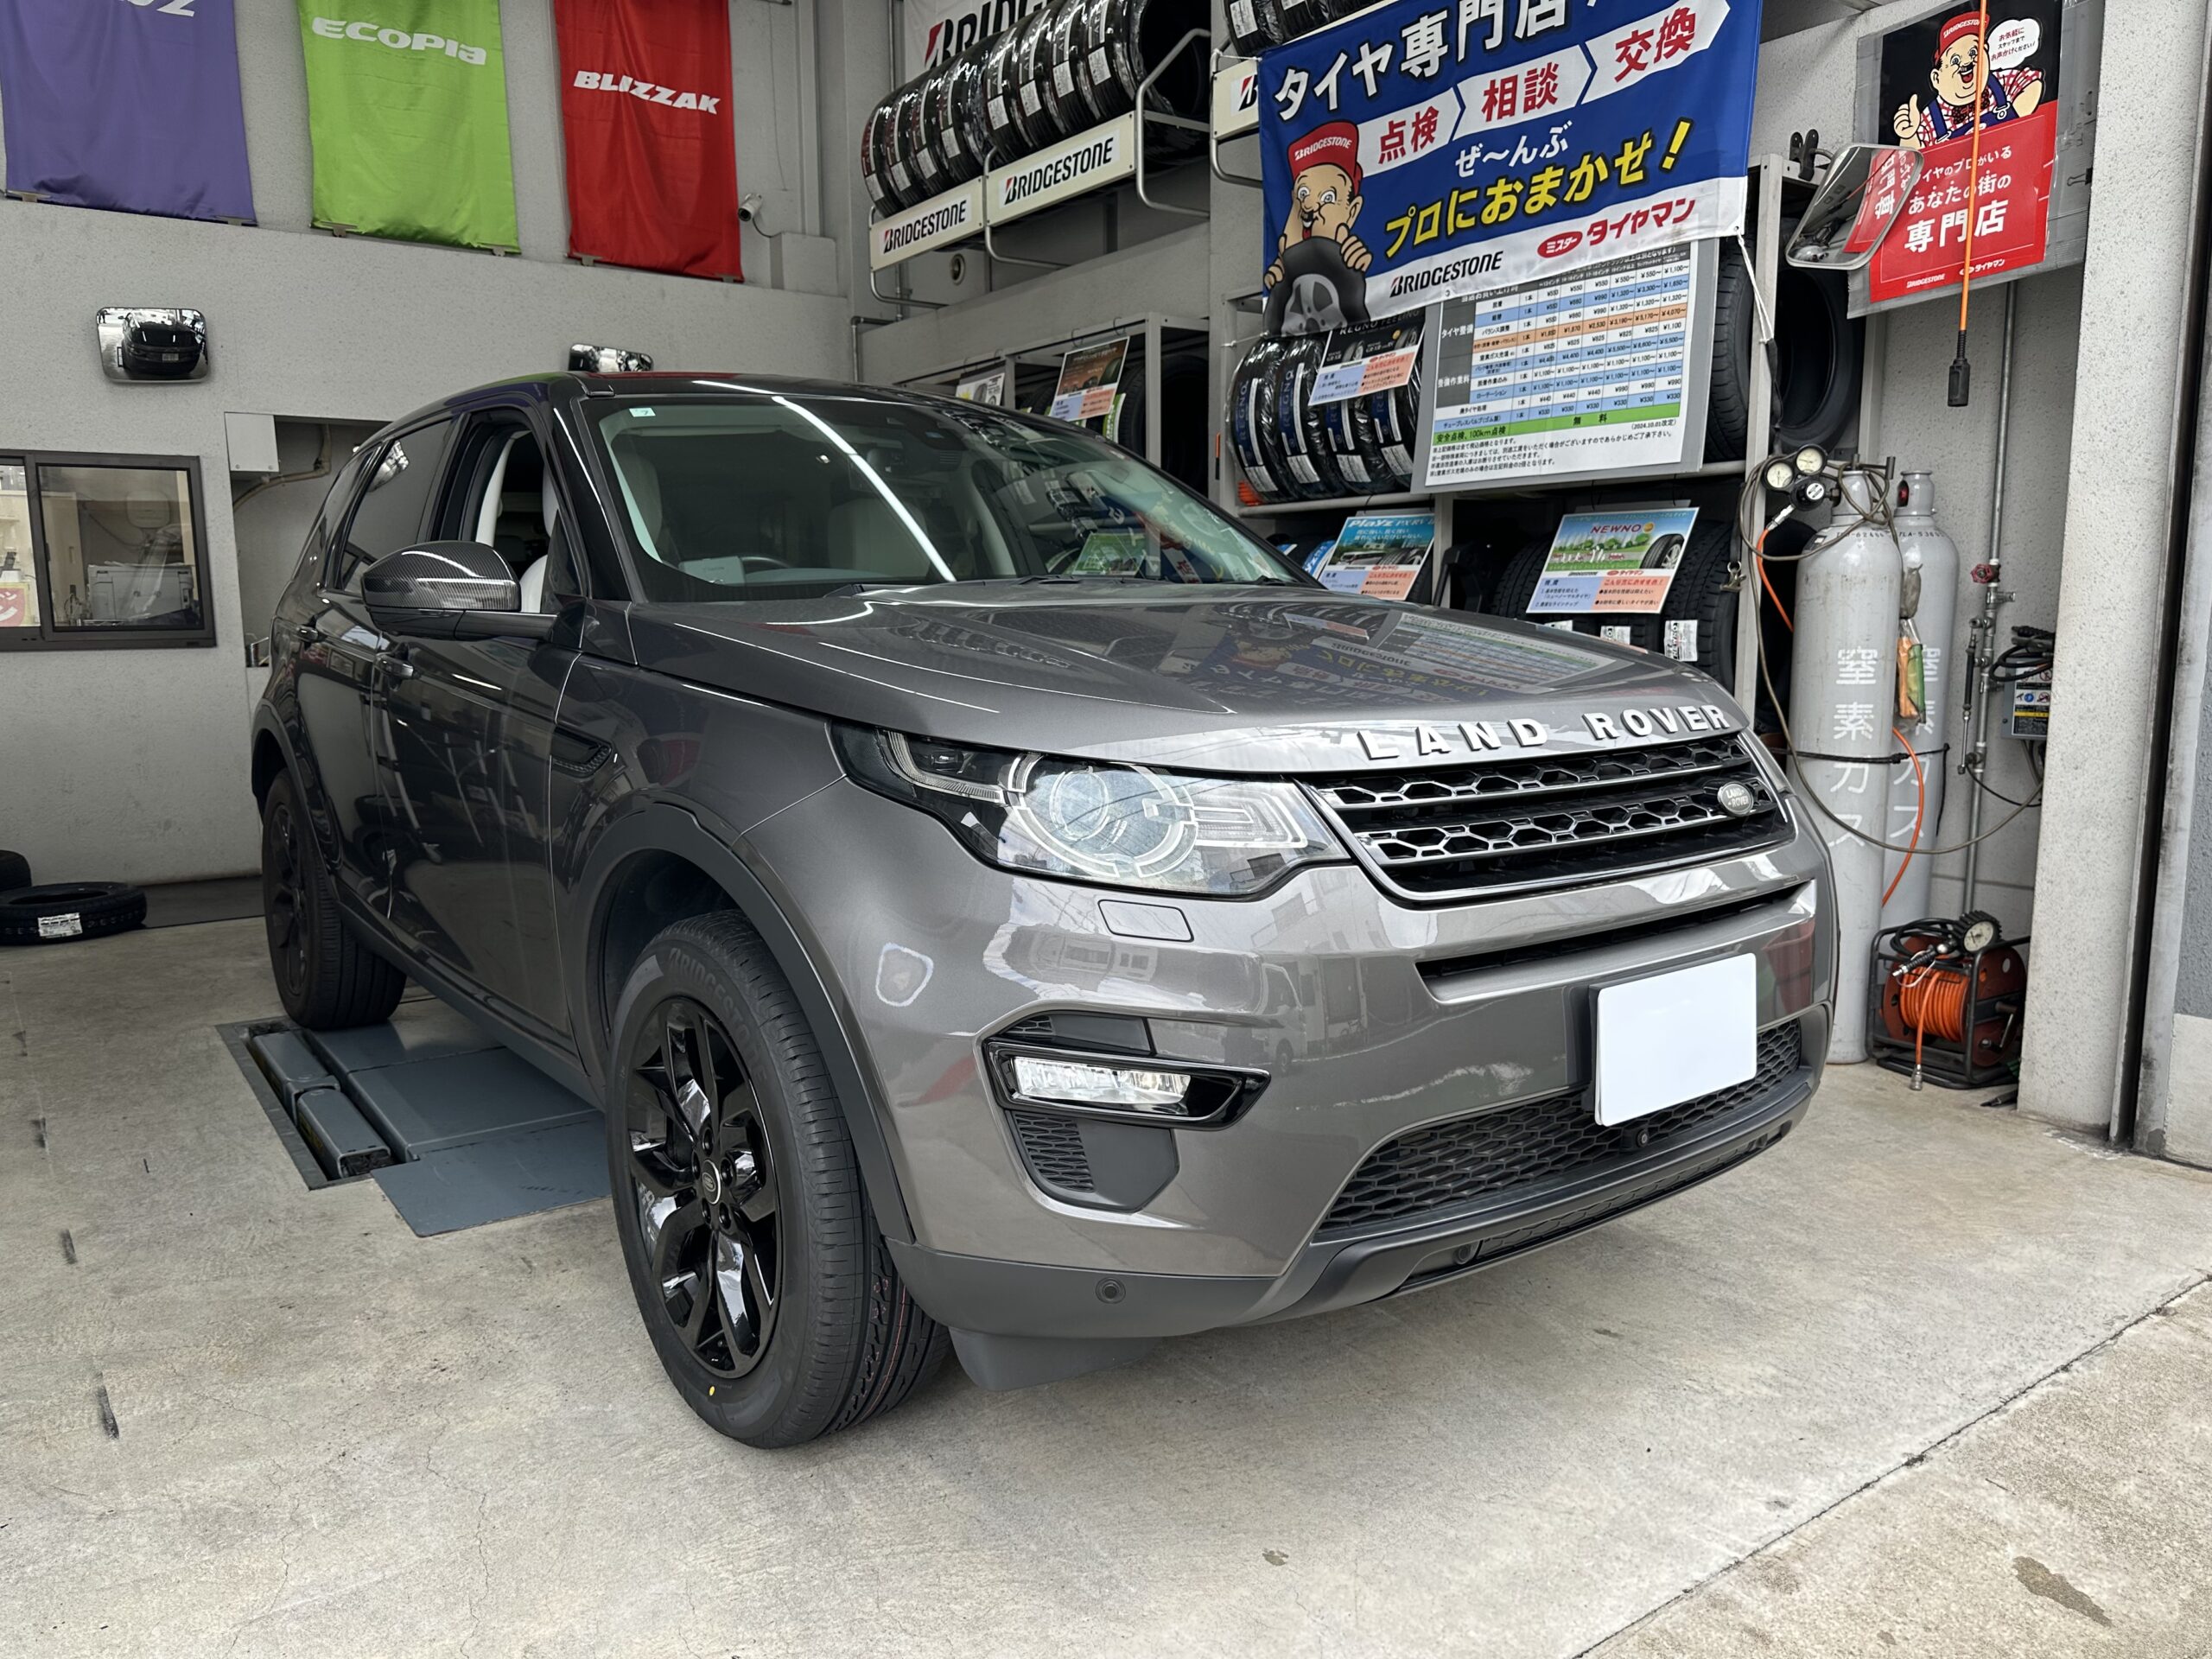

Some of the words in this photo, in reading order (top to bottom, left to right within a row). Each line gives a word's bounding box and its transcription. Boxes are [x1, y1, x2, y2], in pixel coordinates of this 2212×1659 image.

[1274, 0, 1597, 121] タイヤ専門店
[1377, 105, 1440, 164] 点検
[1482, 61, 1560, 123] 相談
[1614, 6, 1697, 83] 交換
[574, 71, 721, 116] BLIZZAK
[1004, 137, 1113, 205] BRIDGESTONE
[1294, 136, 1352, 162] BRIDGESTONE
[1915, 145, 2012, 186] イヤのプロがいる
[1908, 172, 2012, 215] あなたの街の
[883, 200, 966, 254] BRIDGESTONE
[1586, 197, 1696, 247] タイヤマン
[1904, 200, 2009, 253] 専門店
[1389, 250, 1503, 299] BRIDGESTONE
[1906, 274, 1945, 289] BRIDGESTONE
[1591, 524, 1642, 535] NEWNO
[1357, 717, 1549, 760] LAND
[1582, 703, 1731, 741] ROVER
